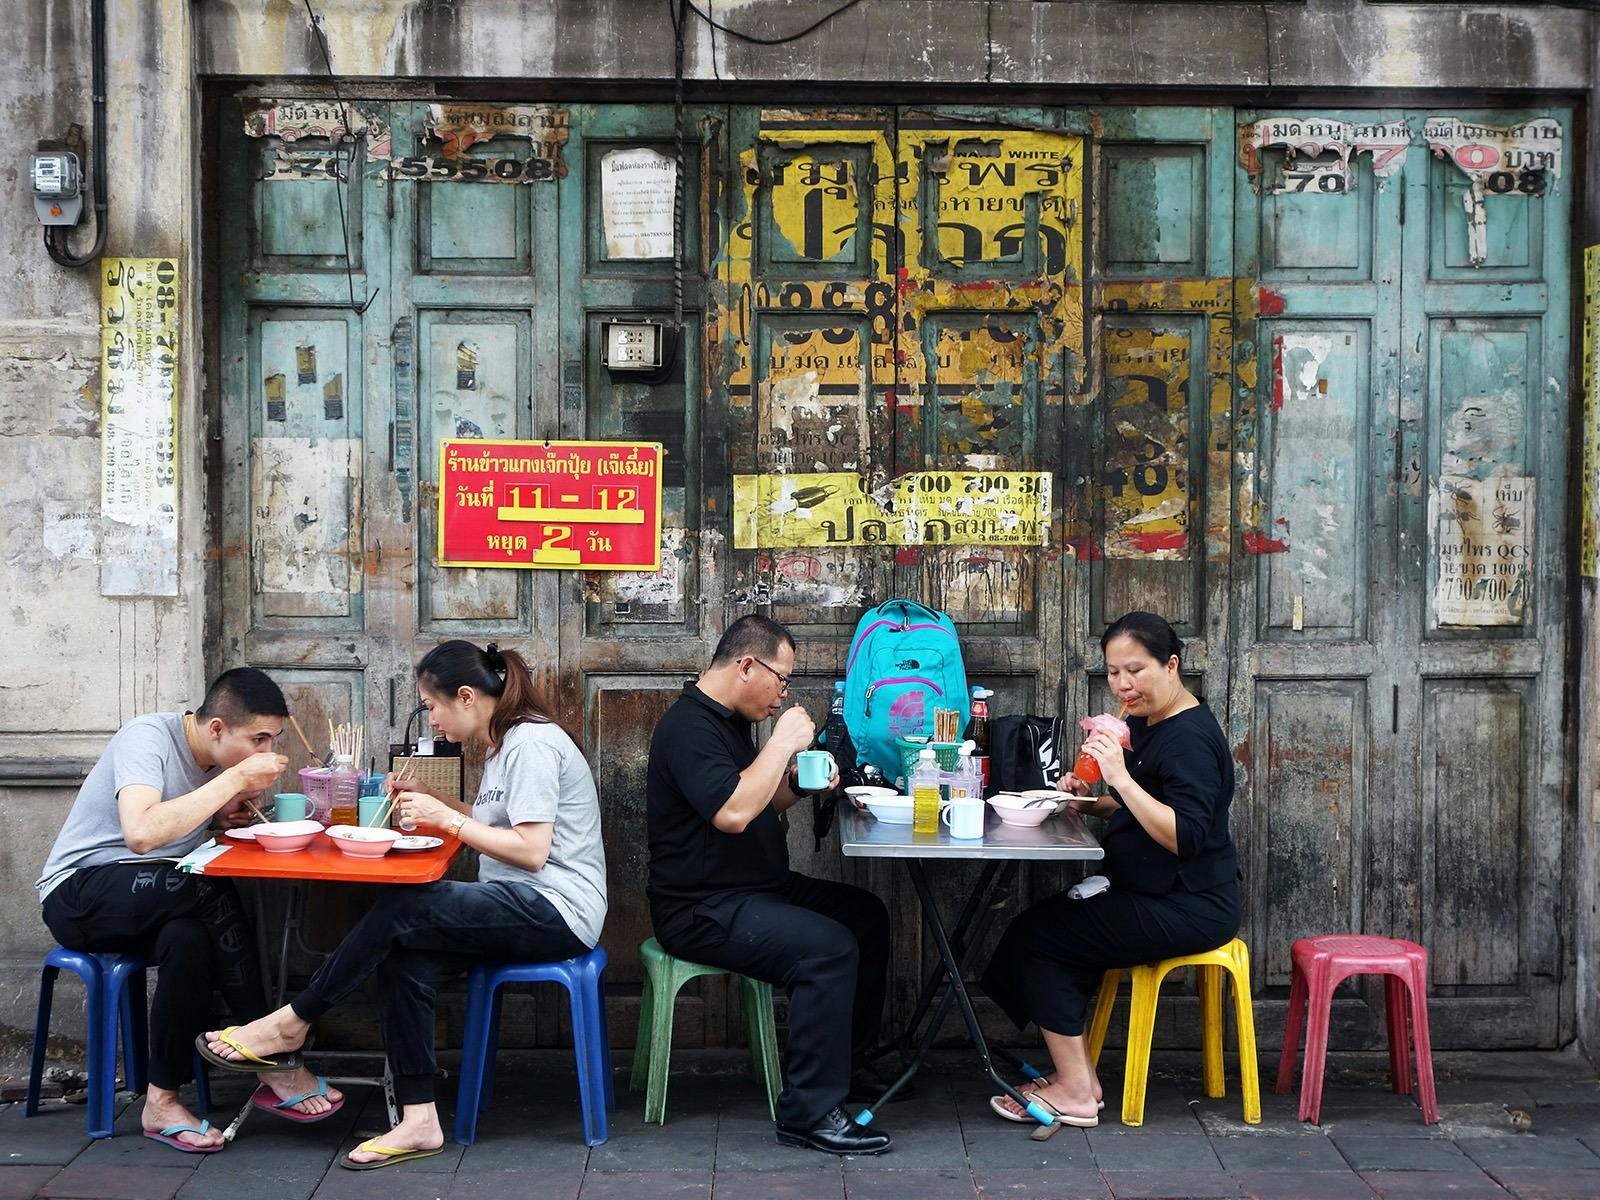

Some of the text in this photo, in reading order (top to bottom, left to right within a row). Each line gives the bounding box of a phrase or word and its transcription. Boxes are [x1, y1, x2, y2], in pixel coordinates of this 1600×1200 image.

[1273, 123, 1302, 137] มด
[1306, 123, 1342, 140] หนู
[1008, 150, 1060, 159] WHITE
[1504, 150, 1556, 169] บาท
[455, 479, 494, 507] วันที่
[508, 486, 543, 508] 11
[597, 488, 636, 510] 12
[1495, 484, 1523, 502] เห็บ
[486, 525, 612, 556] หยุด 2 วัน
[1497, 544, 1531, 559] QCS
